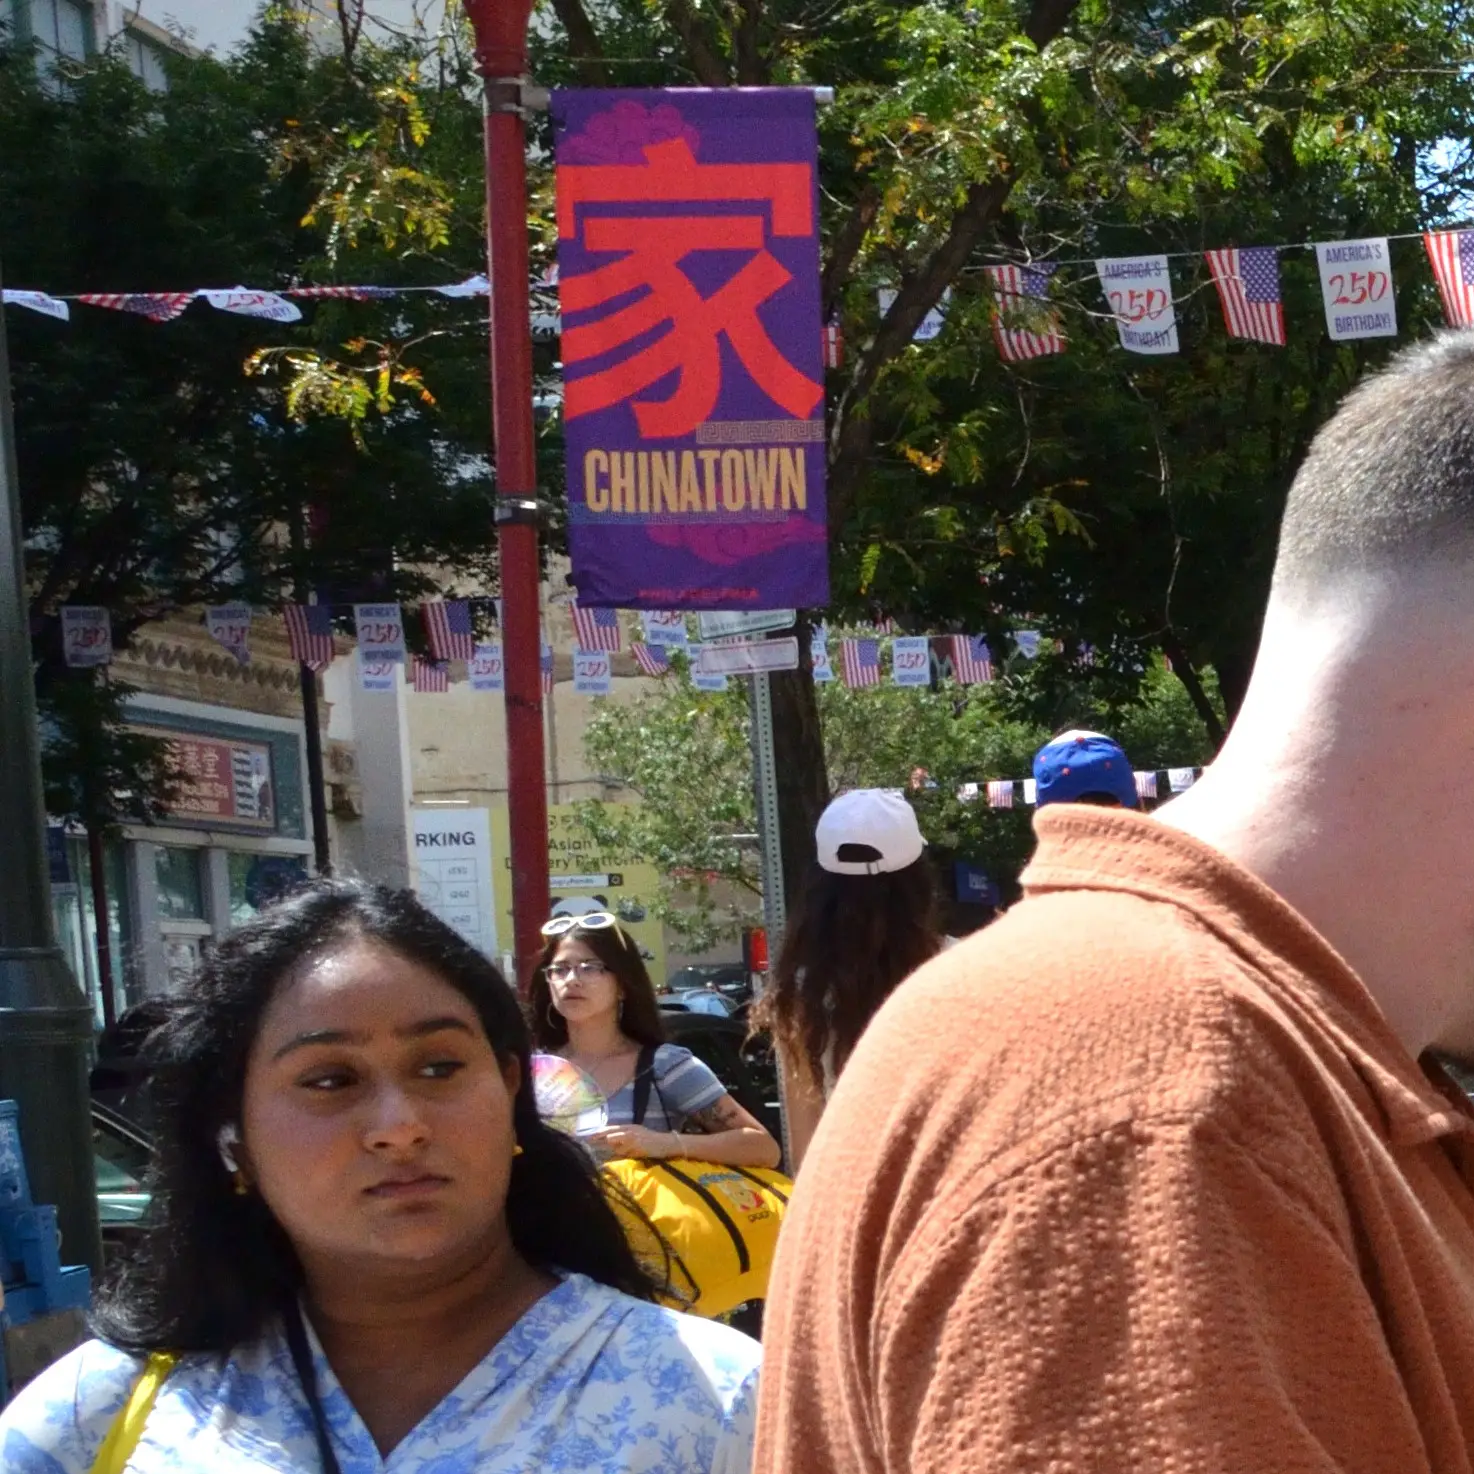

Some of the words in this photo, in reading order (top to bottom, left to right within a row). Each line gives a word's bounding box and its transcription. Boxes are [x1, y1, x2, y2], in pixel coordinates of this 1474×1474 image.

[1325, 243, 1382, 264] AMERICA'S
[1104, 261, 1162, 280] AMERICA'S
[555, 137, 824, 440] 家
[1328, 271, 1388, 306] 250
[1109, 288, 1168, 321] 250
[1335, 312, 1392, 333] BIRTHDAY!
[584, 448, 807, 513] CHINATOWN
[361, 623, 401, 644] 250
[895, 653, 926, 669] 250
